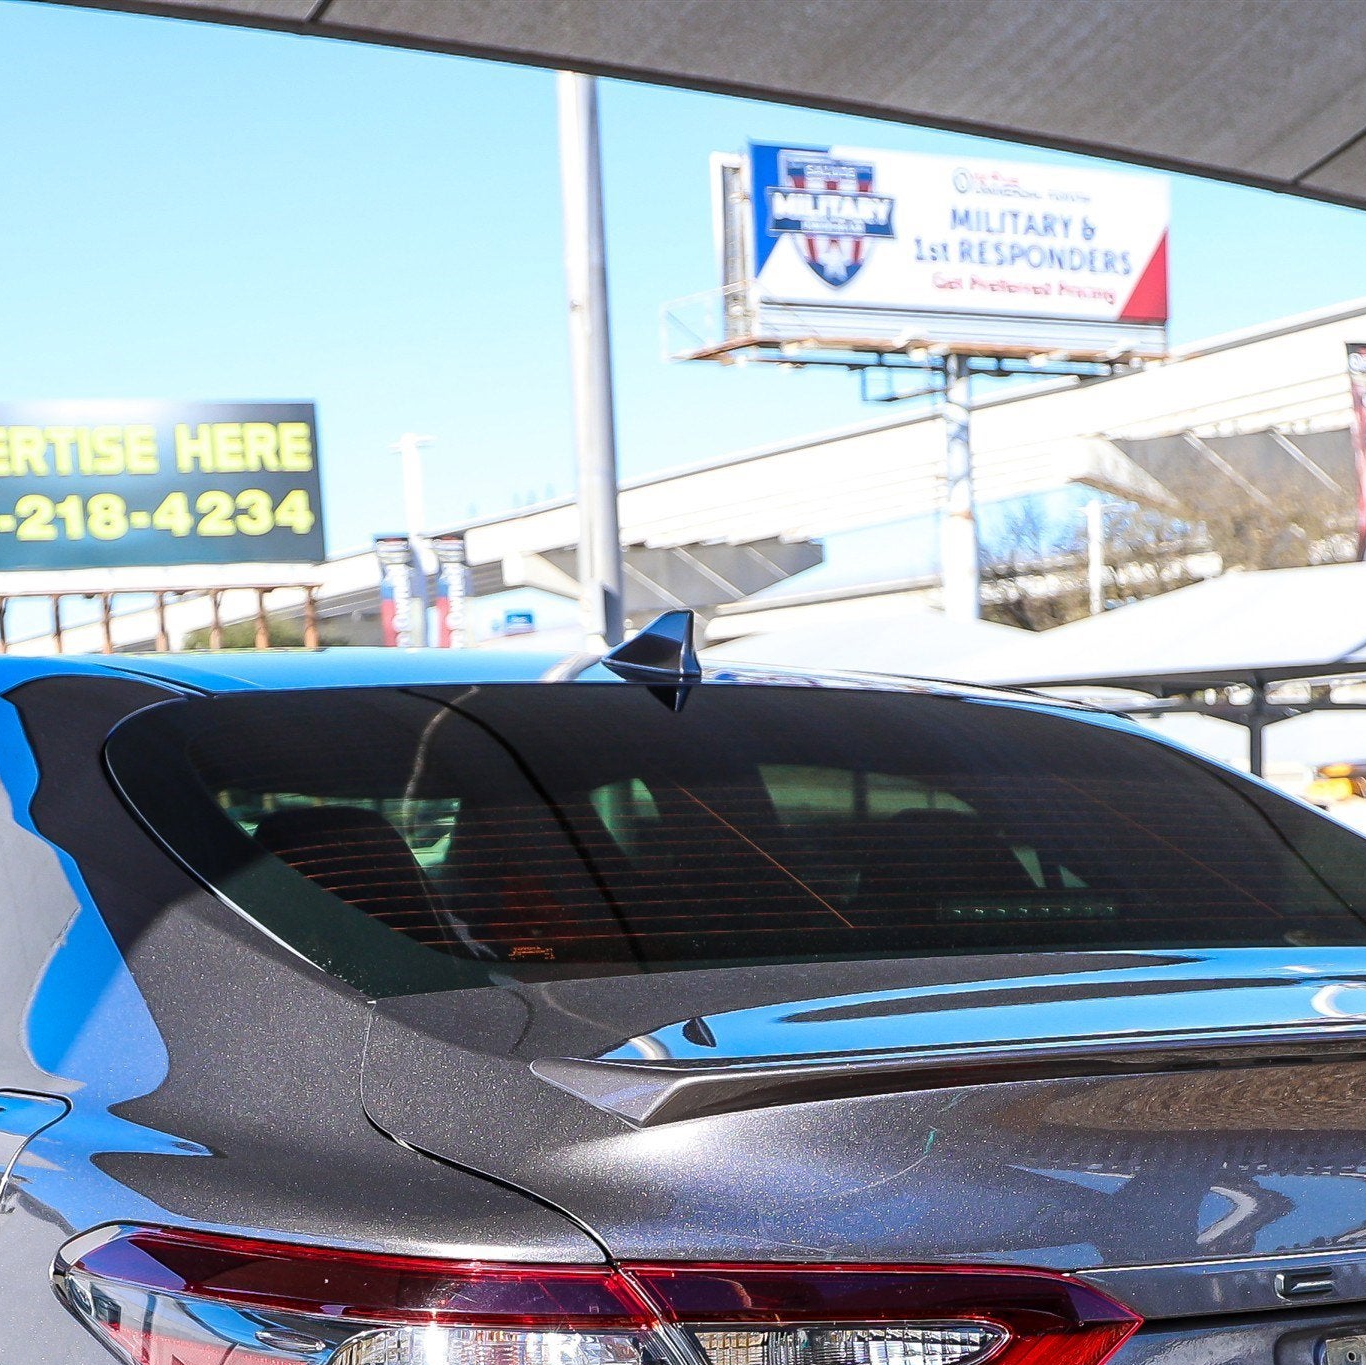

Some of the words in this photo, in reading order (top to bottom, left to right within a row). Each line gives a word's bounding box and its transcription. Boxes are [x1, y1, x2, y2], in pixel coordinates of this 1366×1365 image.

[771, 191, 893, 226] MILITARY
[950, 206, 1072, 239] MILITARY
[914, 237, 950, 263] 1st
[958, 239, 1133, 276] RESPONDERS
[174, 421, 314, 474] HERE
